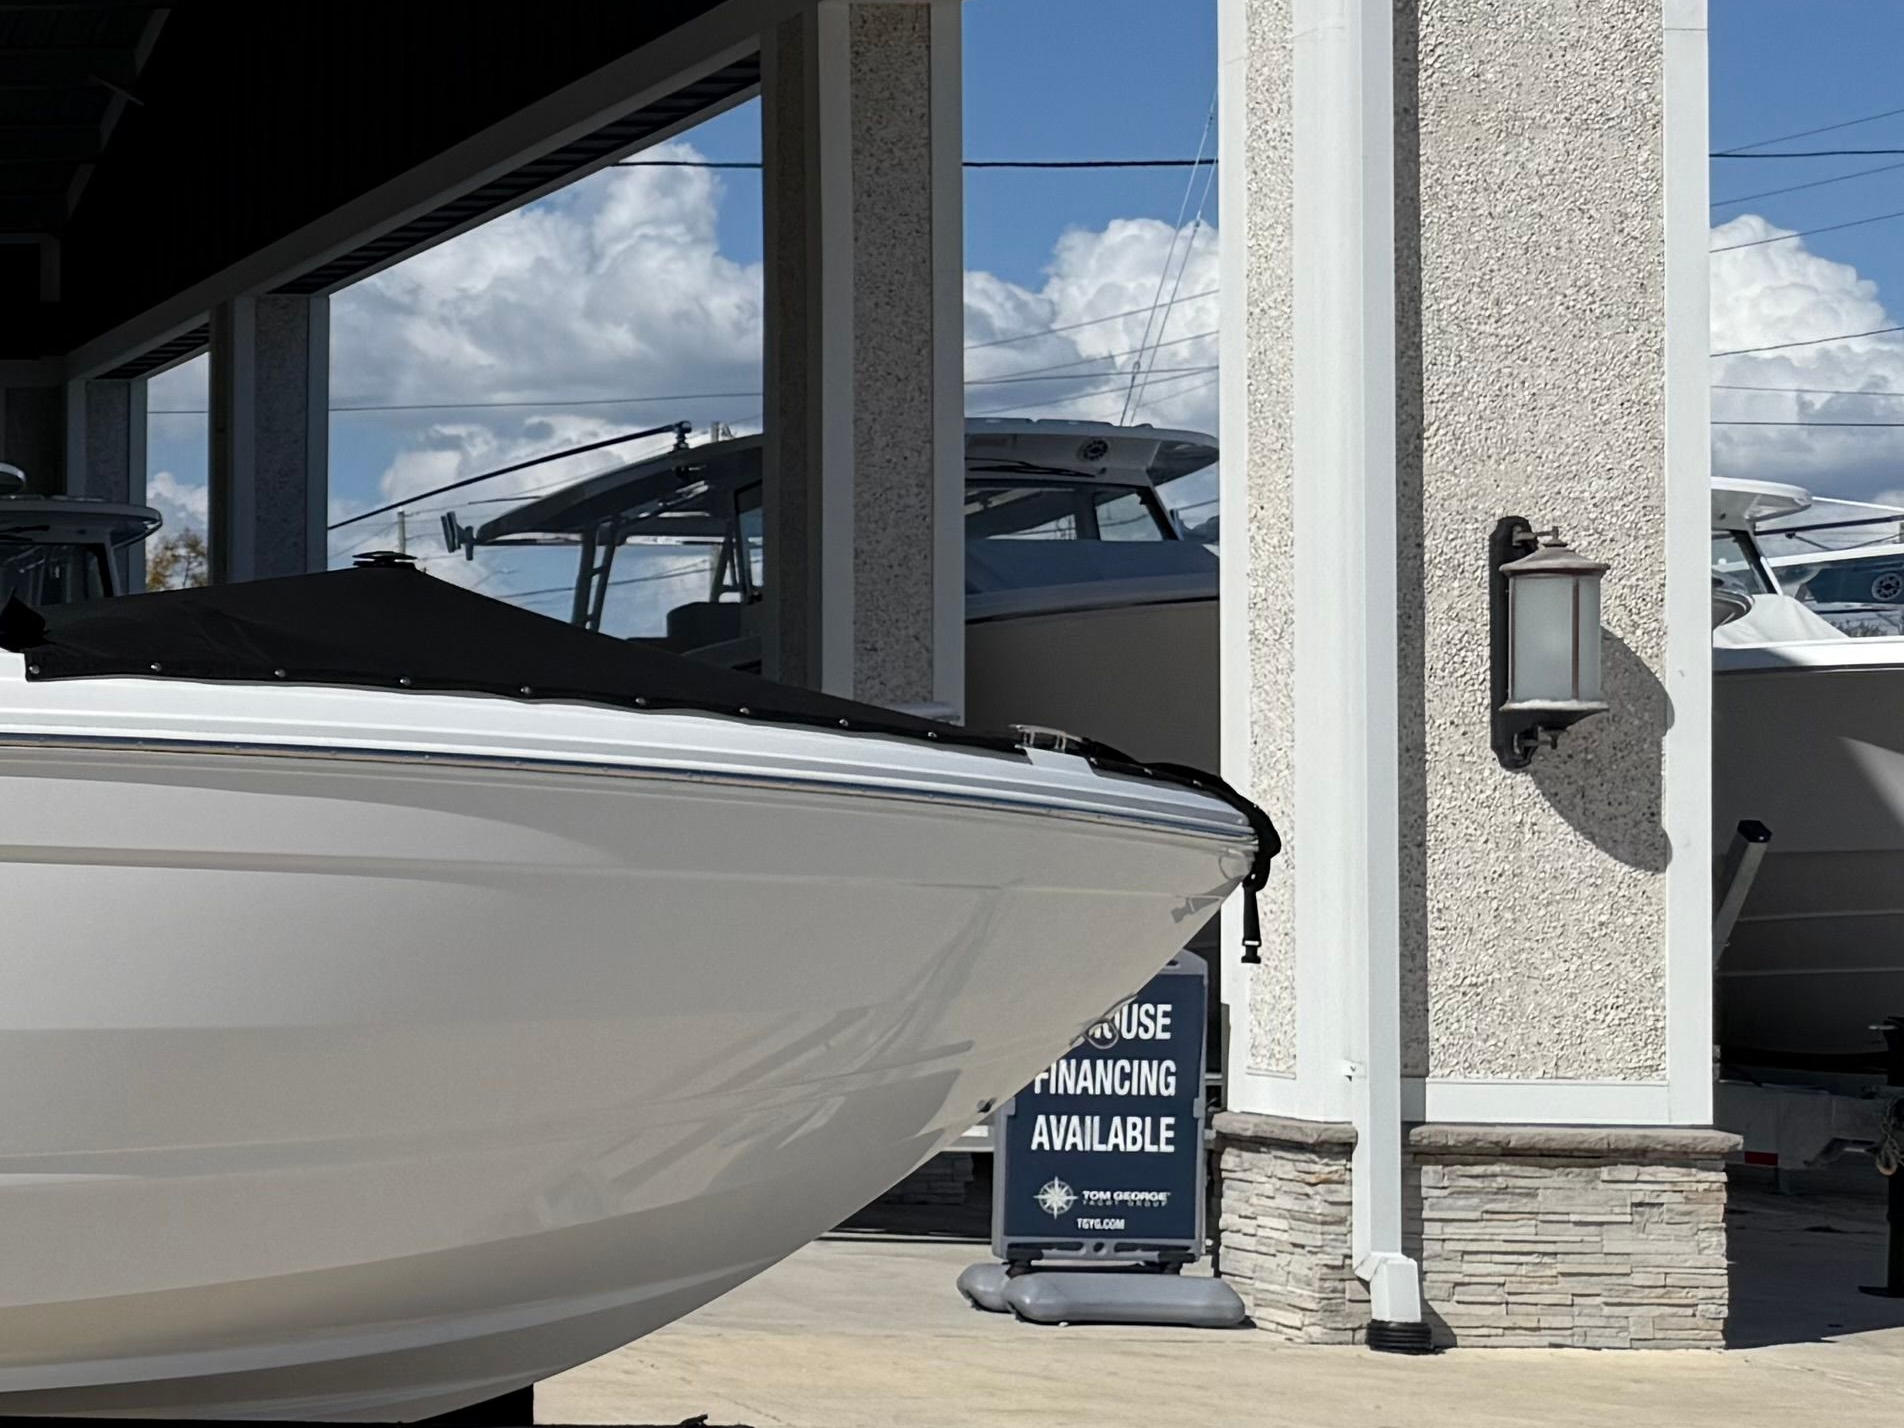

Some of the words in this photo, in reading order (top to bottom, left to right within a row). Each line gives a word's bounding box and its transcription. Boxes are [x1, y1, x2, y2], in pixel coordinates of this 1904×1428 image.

[1034, 1058, 1177, 1097] FINANCING
[1030, 1114, 1176, 1153] AVAILABLE
[1082, 1190, 1111, 1201] TOM
[1076, 1217, 1125, 1230] TGYG.COM
